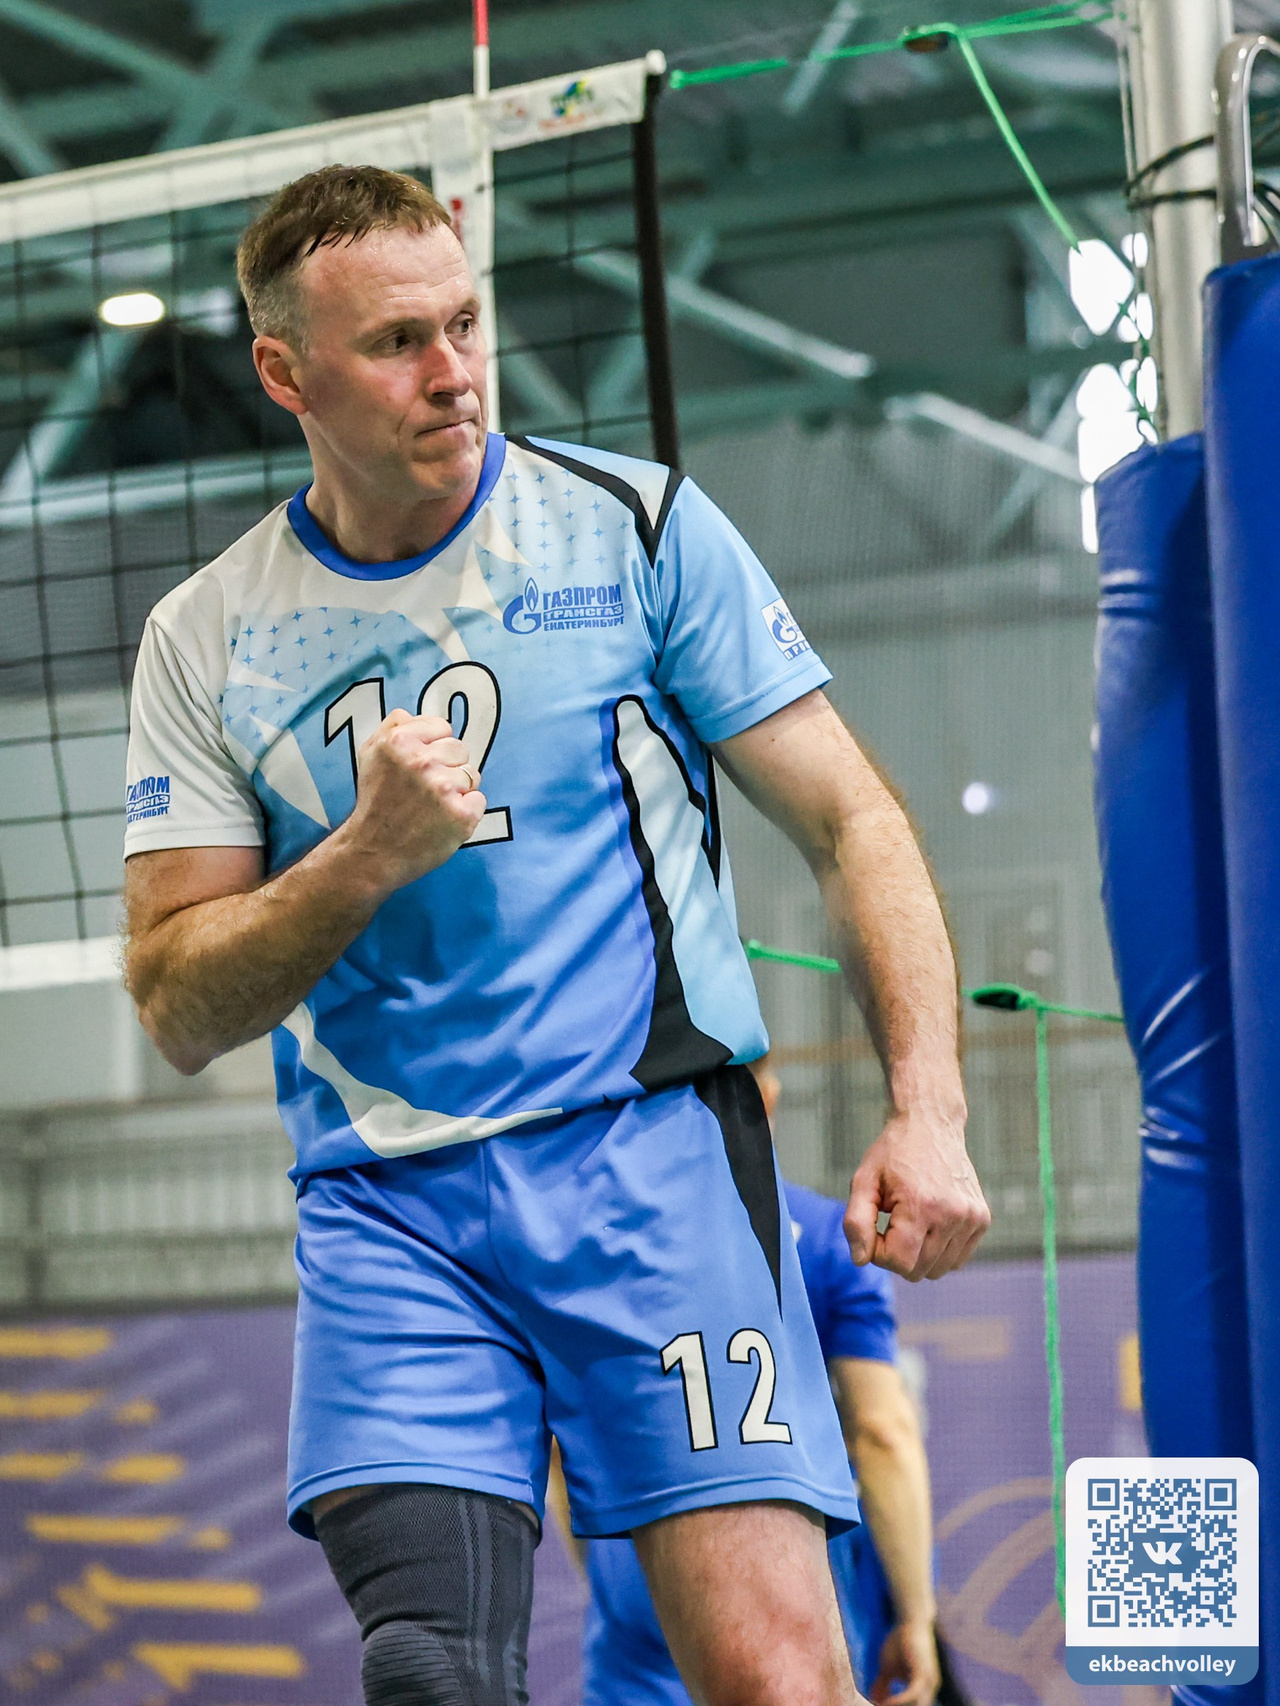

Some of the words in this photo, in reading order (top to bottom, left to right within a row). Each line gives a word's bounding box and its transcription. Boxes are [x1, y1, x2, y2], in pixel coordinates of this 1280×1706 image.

[542, 583, 622, 611] ГАЗПРОМ
[544, 605, 623, 620] ТРАНСГАЗ
[543, 616, 625, 631] ЕКАТЕРИНБУРГ
[659, 1327, 793, 1453] 12
